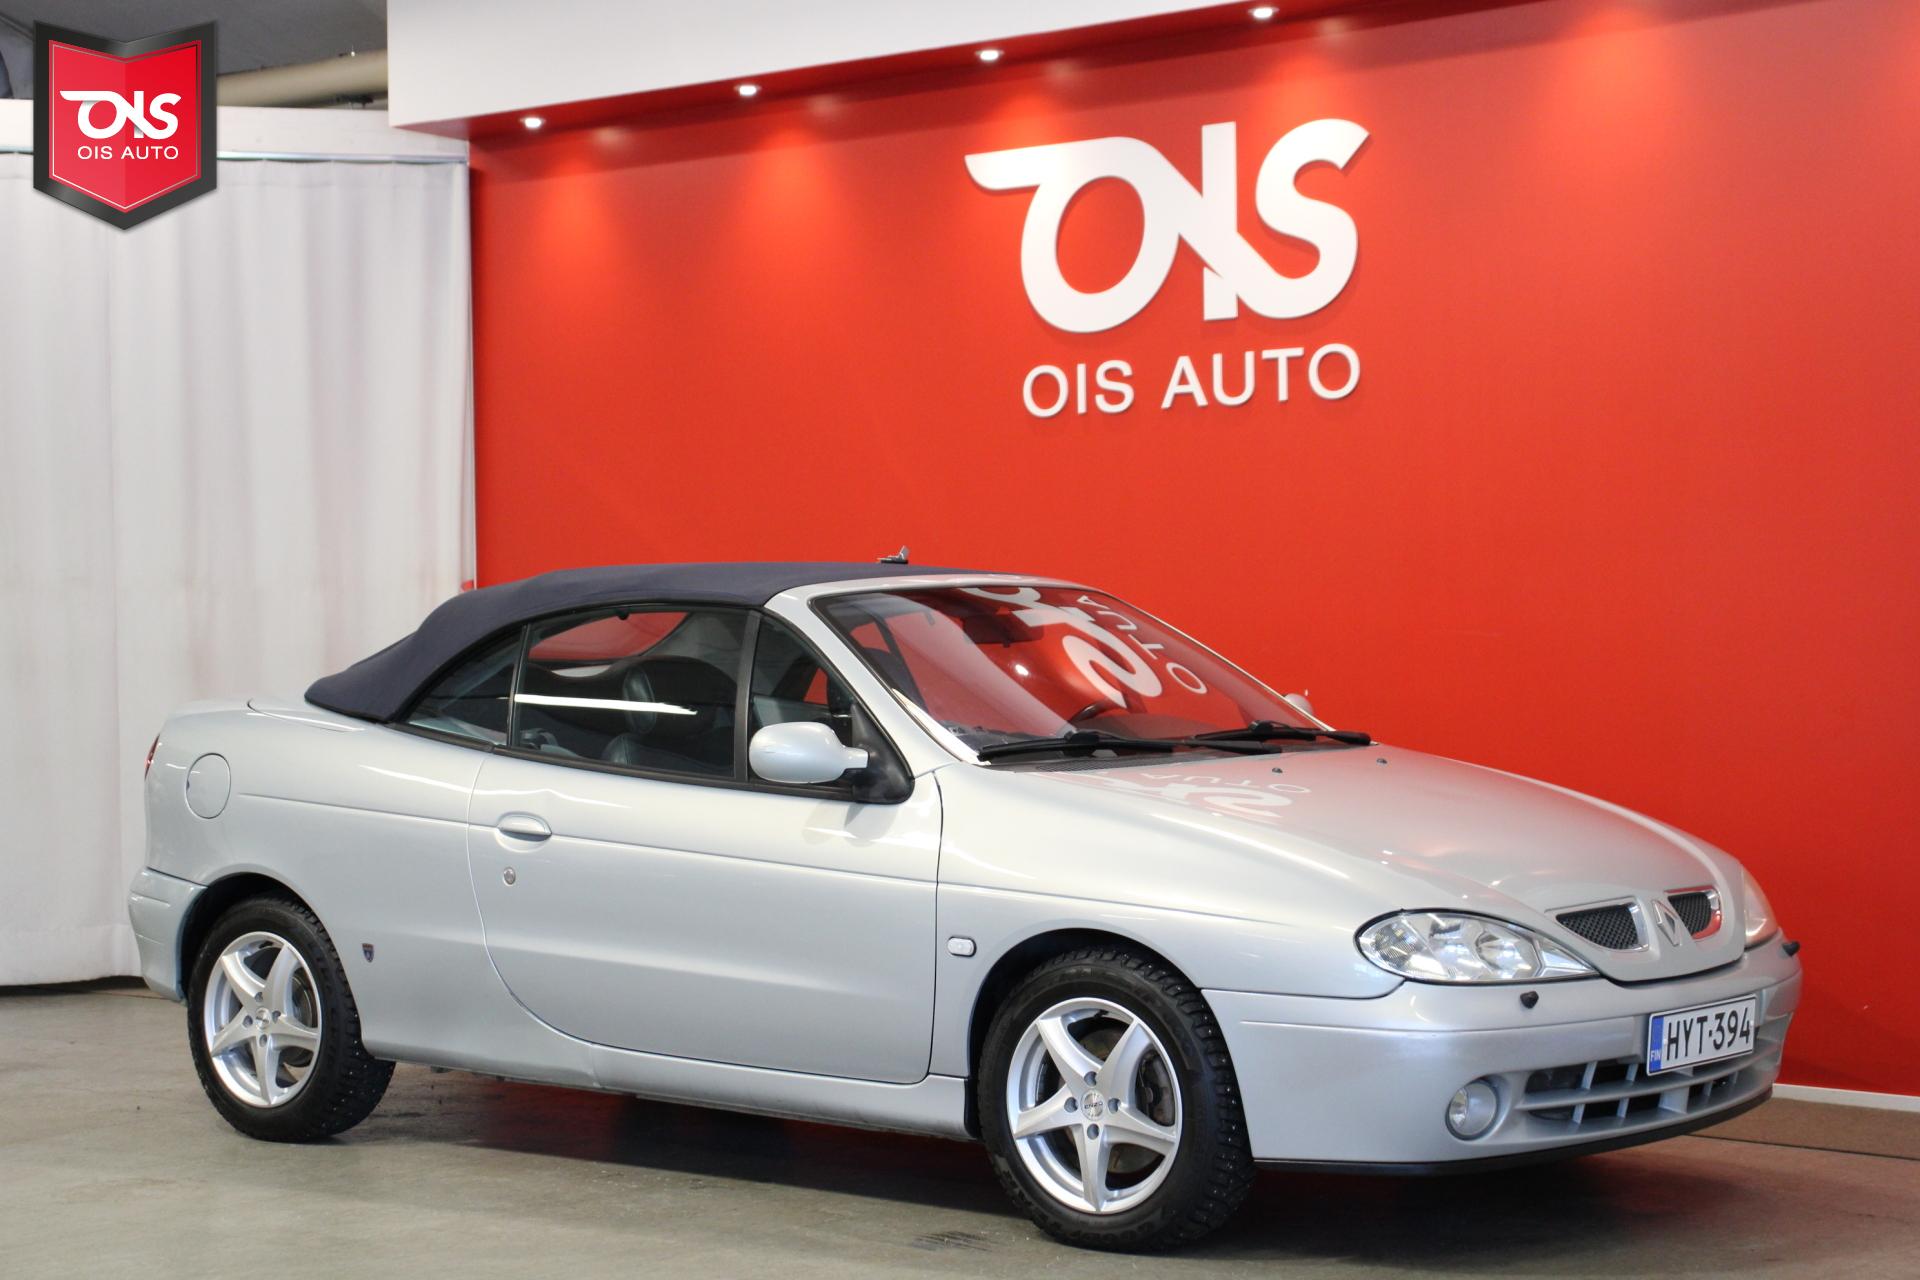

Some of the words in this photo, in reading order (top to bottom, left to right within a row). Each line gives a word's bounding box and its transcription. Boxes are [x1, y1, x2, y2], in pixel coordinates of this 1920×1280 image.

[1022, 359, 1134, 418] OIS
[1161, 343, 1361, 410] AUTO
[1666, 1007, 1750, 1060] HYT-394
